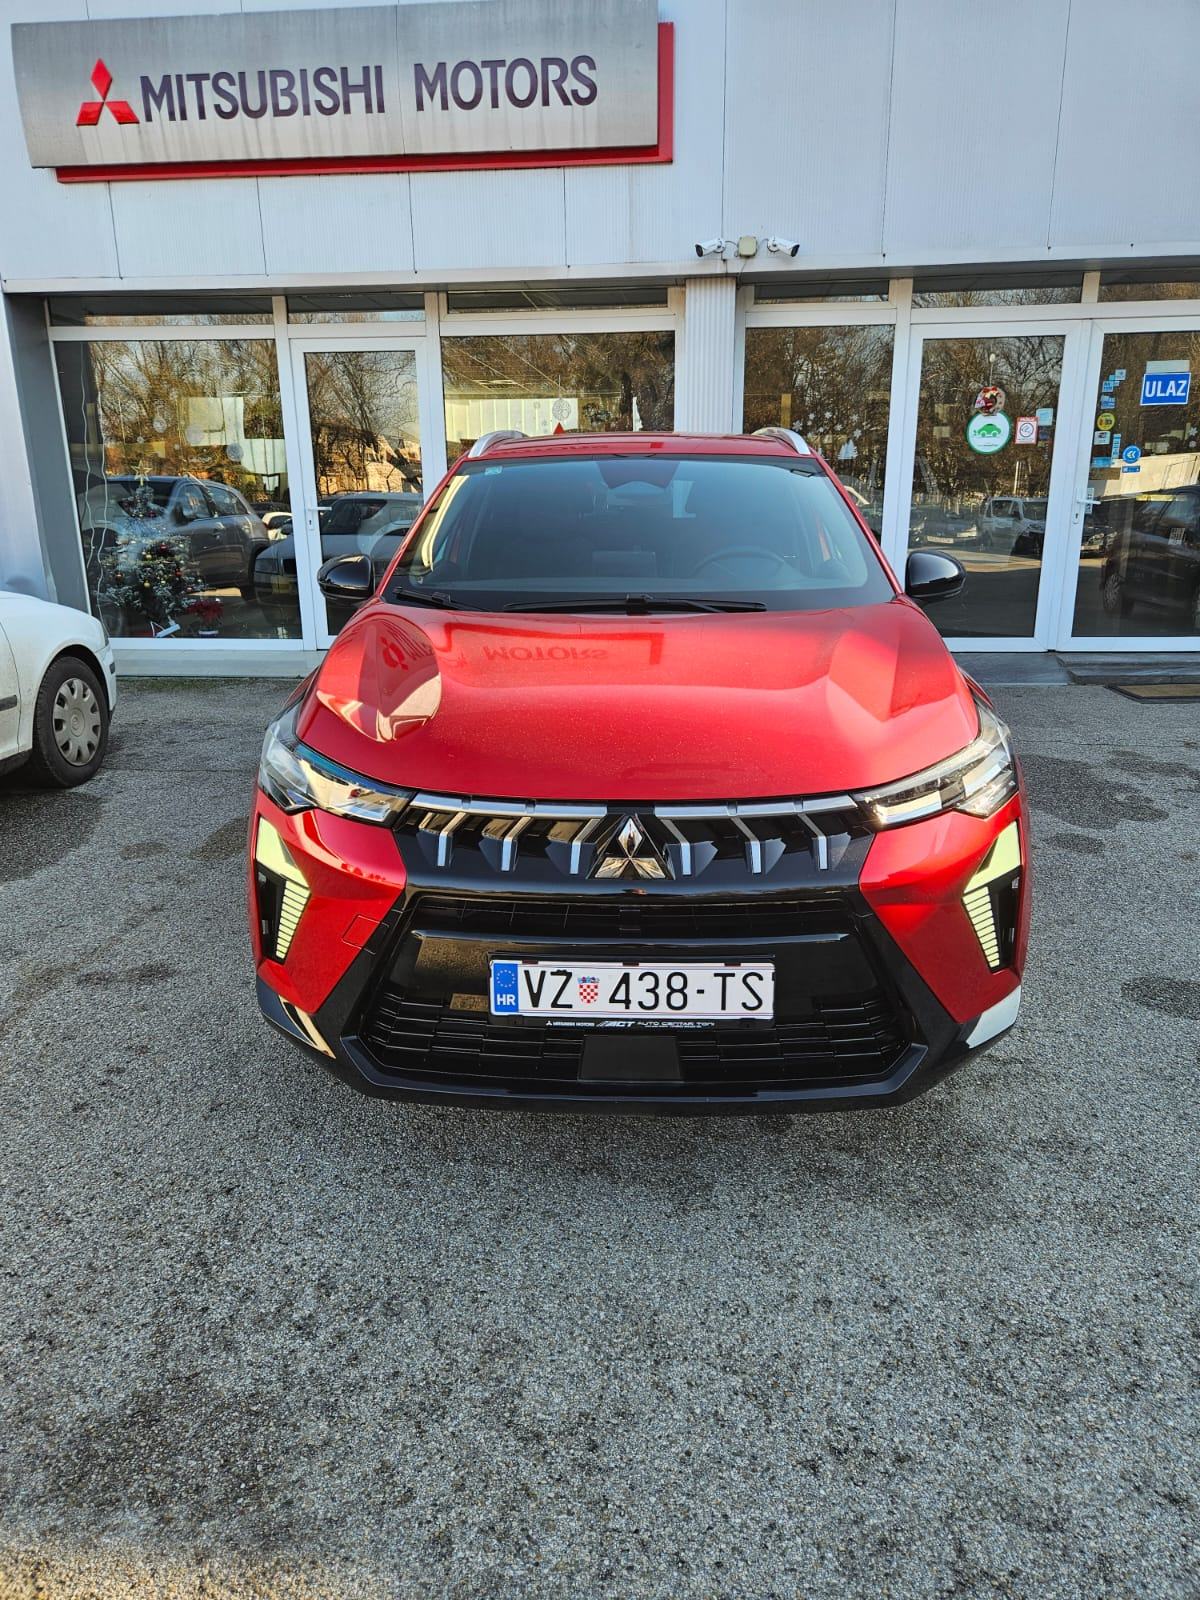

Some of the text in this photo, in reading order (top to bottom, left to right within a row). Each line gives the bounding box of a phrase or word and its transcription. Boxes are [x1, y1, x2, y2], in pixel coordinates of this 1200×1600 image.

[140, 55, 598, 122] MITSUBISHI MOTORS
[1144, 380, 1188, 398] ULAZ
[496, 993, 516, 1006] HR
